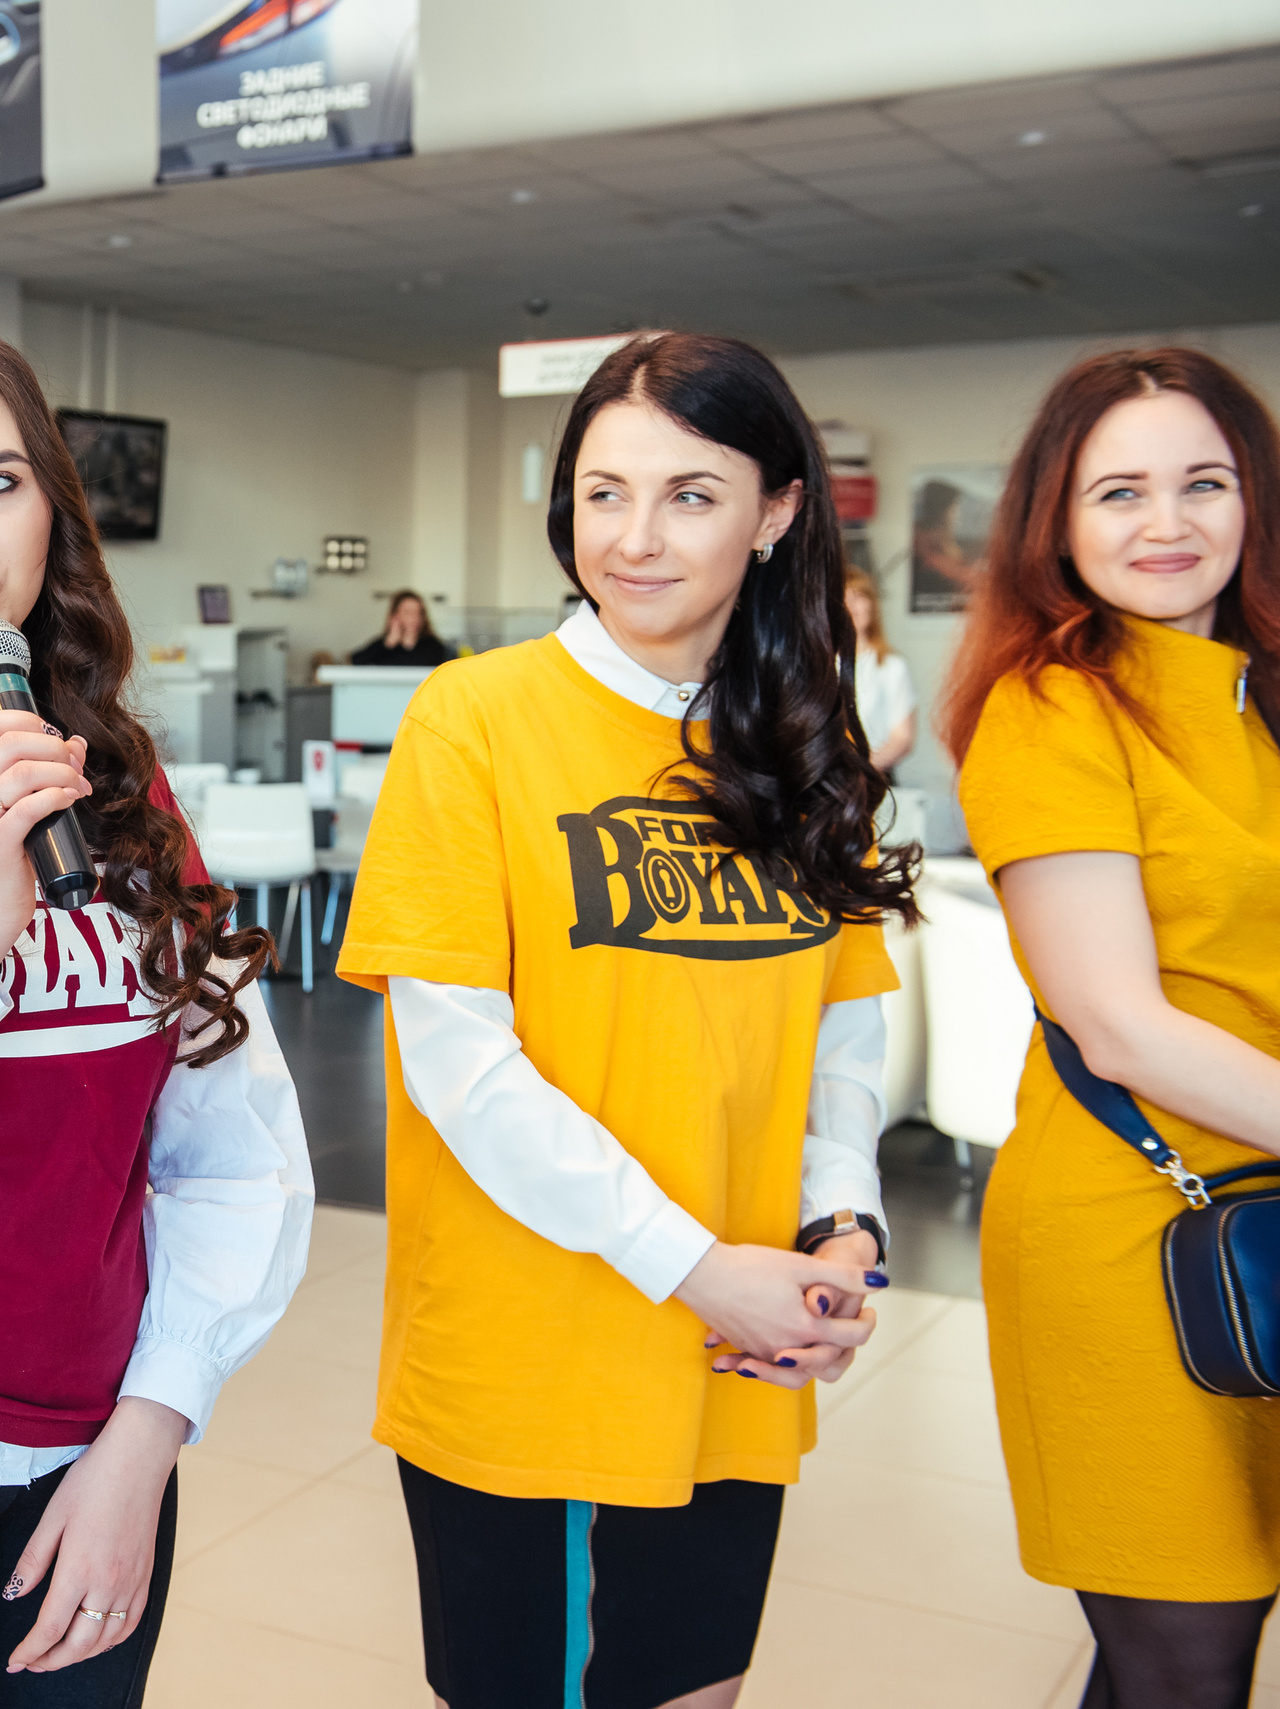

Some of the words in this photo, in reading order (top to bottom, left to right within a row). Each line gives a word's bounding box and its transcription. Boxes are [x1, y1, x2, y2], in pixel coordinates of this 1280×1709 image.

[239, 61, 325, 97] ЗАДНИЕ
[196, 81, 370, 129] СВЕТОДИОДНЫЕ
[557, 812, 841, 950] BOYAR
